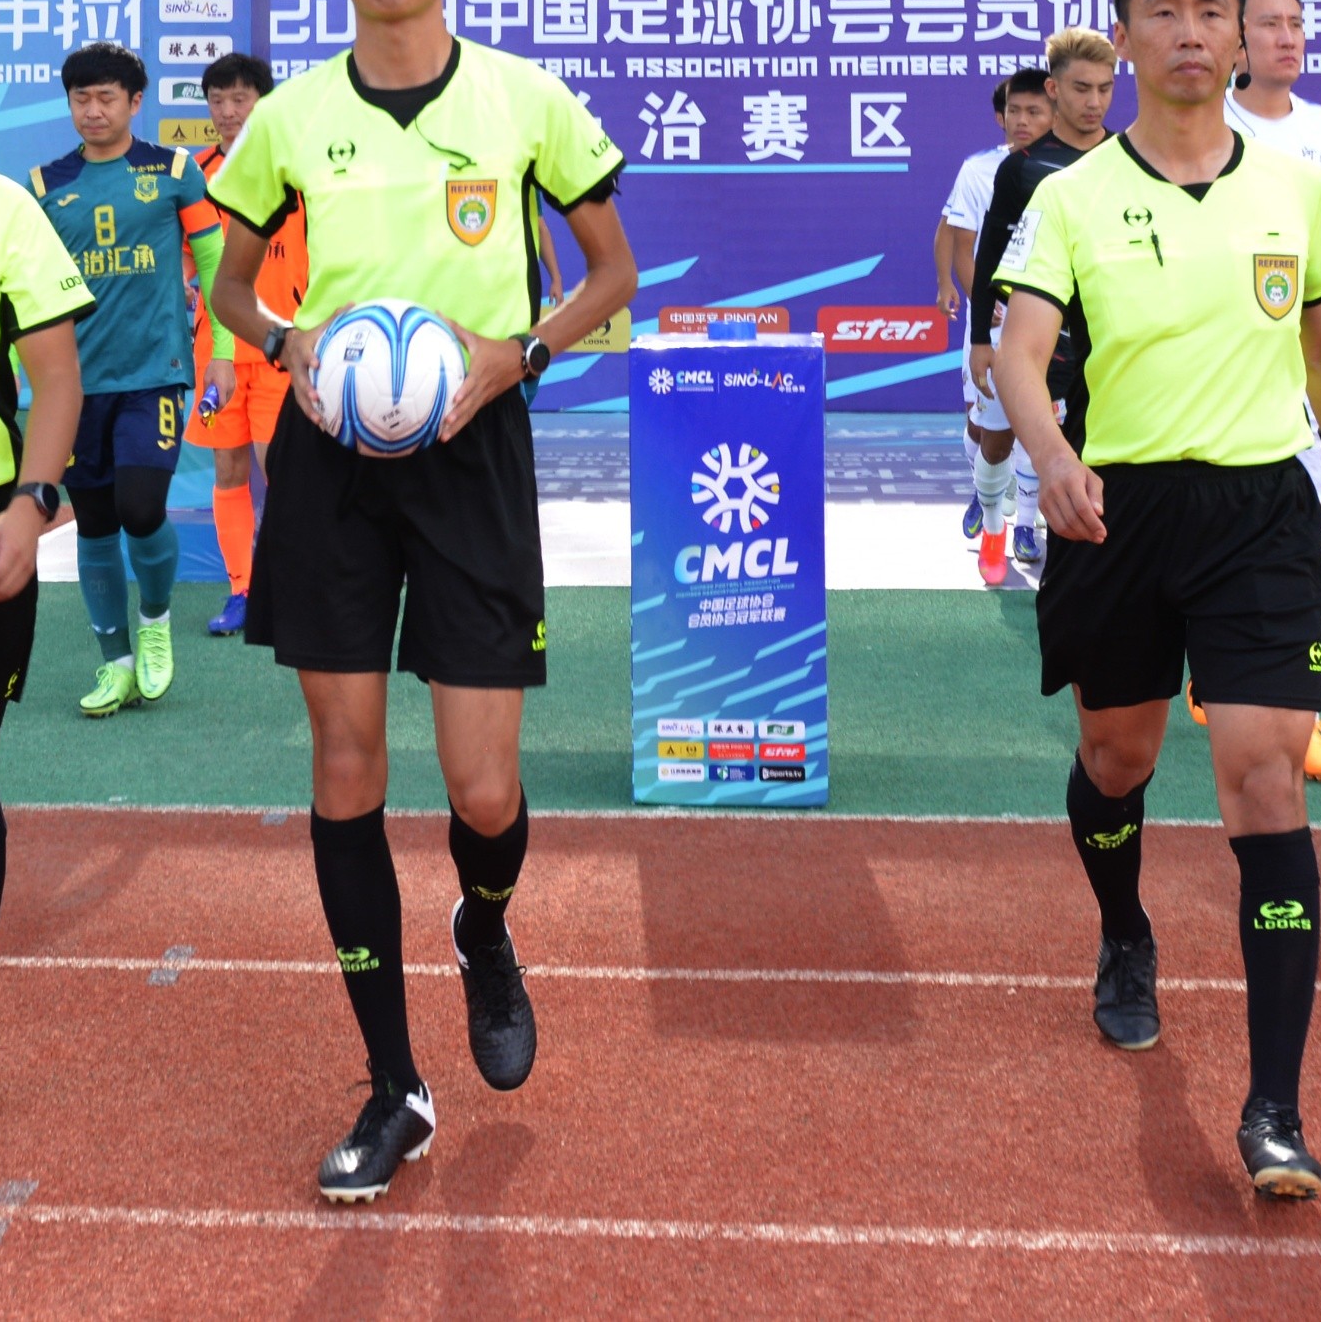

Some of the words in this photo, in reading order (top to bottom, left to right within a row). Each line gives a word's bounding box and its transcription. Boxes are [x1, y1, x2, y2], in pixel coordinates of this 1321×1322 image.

[549, 57, 616, 79] BALL
[627, 57, 818, 79] ASSOCIATION
[830, 55, 968, 77] MEMBER
[576, 89, 912, 162] 治赛区
[450, 184, 496, 194] REFEREE
[94, 204, 116, 246] 8
[1258, 258, 1296, 269] REFEREE
[583, 338, 611, 346] LOOKS
[676, 370, 715, 385] CMCL
[723, 371, 794, 389] SINO-LAC
[159, 396, 176, 438] 8
[673, 537, 799, 585] CMCL
[699, 592, 775, 613] 中国足球协会
[688, 606, 787, 629] 会员协会冠军联赛
[1253, 918, 1312, 931] LOOKS
